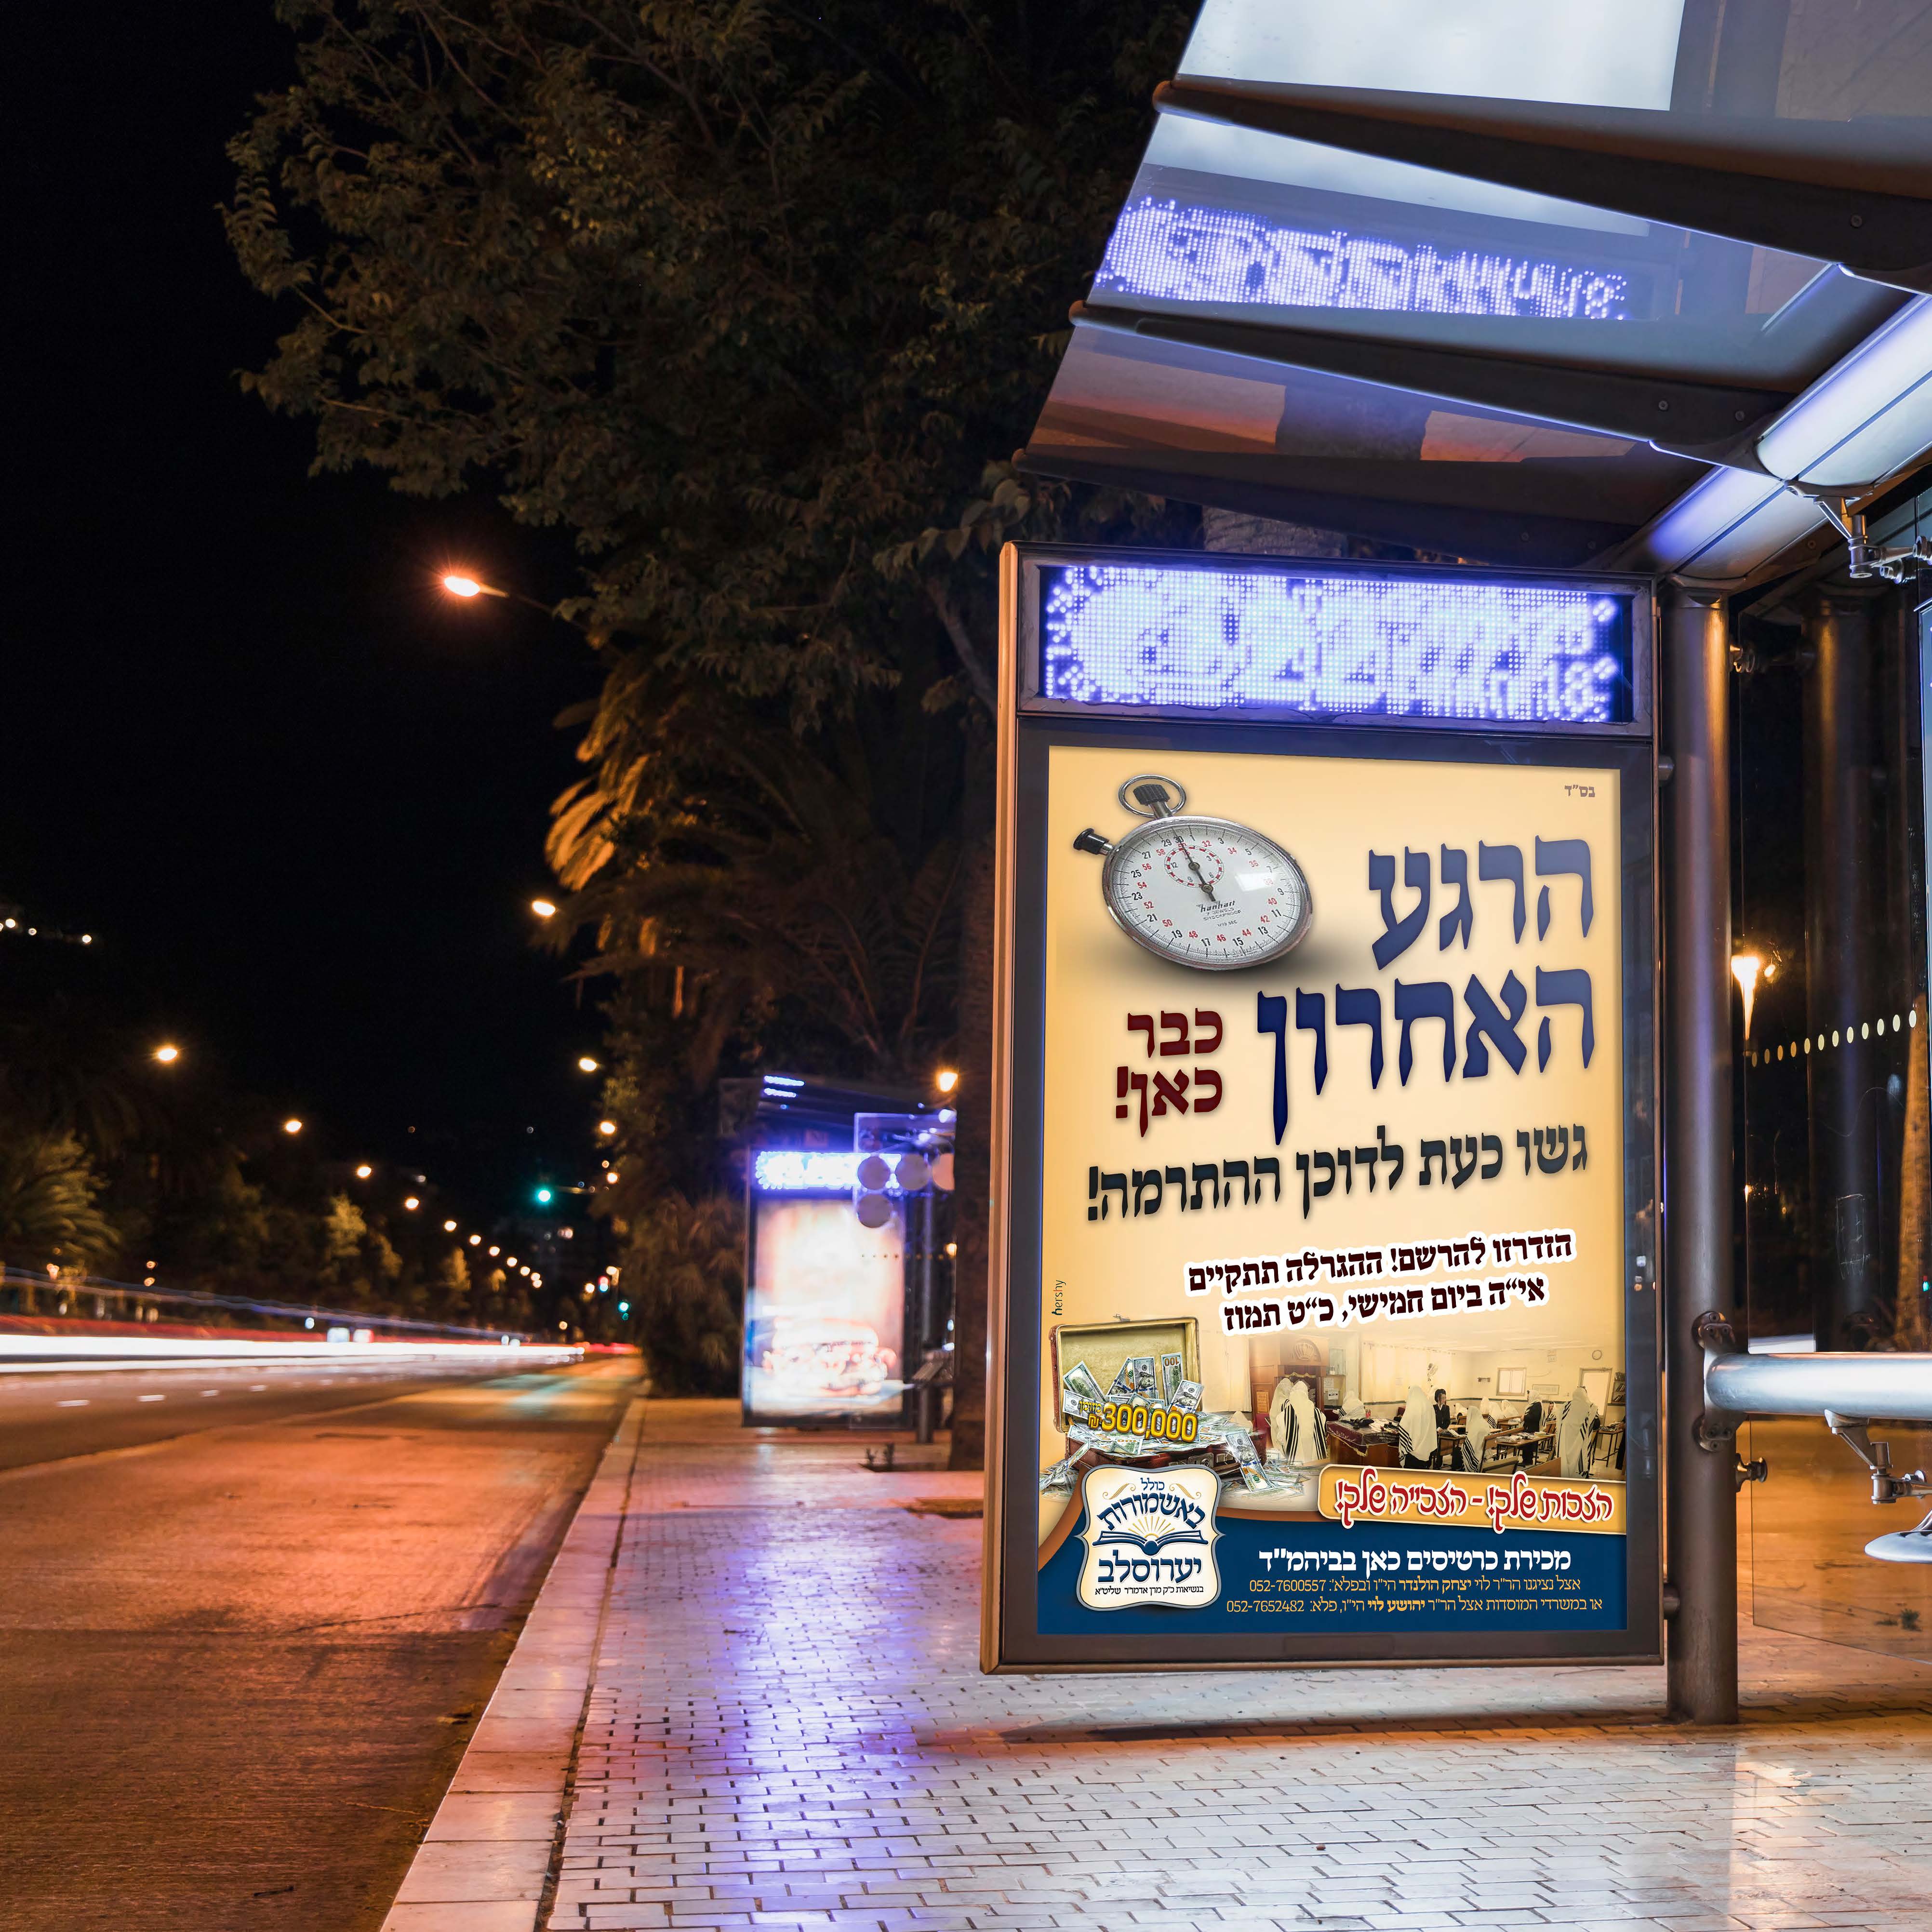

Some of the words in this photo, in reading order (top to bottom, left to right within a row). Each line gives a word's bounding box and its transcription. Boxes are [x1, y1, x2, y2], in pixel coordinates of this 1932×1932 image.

[1161, 839, 1172, 847] 29
[1142, 851, 1152, 859] 27
[1156, 848, 1166, 856] 58
[1131, 869, 1142, 878] 25
[1132, 892, 1143, 901] 23
[1369, 835, 1593, 970] הרגע
[1144, 901, 1154, 909] 52
[1147, 914, 1158, 922] 21
[1260, 915, 1271, 923] 42
[1271, 909, 1282, 918] 11
[1162, 919, 1173, 928] 50
[1258, 926, 1268, 935] 13
[1171, 929, 1183, 938] 19
[1188, 930, 1199, 939] 48
[1216, 934, 1226, 942] 46
[1241, 928, 1252, 936] 44
[1200, 937, 1211, 946] 17
[1233, 937, 1244, 946] 15
[1128, 1008, 1223, 1058] כבר
[1257, 965, 1595, 1146] האחרון
[1116, 1066, 1222, 1137] כאן!
[1517, 1124, 1587, 1176] גשו
[1419, 1133, 1503, 1189] כעת
[1296, 1125, 1403, 1219] לדוכן
[1088, 1156, 1280, 1221] ההתרמה!
[1391, 1237, 1485, 1272] להרשם!
[1493, 1234, 1572, 1262] הזדרזו
[1286, 1252, 1382, 1282] ההגרלה
[1189, 1261, 1279, 1293] תתקיים
[1052, 1279, 1066, 1316] hershy
[1431, 1284, 1482, 1310] ביום
[1489, 1278, 1544, 1305] אי"ה
[1289, 1300, 1334, 1325] כ"ט
[1342, 1290, 1423, 1322] חמישי,
[1225, 1305, 1280, 1331] תמוז
[1164, 1357, 1179, 1366] 100
[1140, 1478, 1165, 1491] כולל
[1097, 1493, 1205, 1531] באשמורות
[1098, 1550, 1201, 1583] יערוסלב
[1259, 1548, 1356, 1572] בביהמ"ד
[1362, 1550, 1400, 1579] כאן
[1407, 1550, 1498, 1571] כרטיסים
[1504, 1550, 1571, 1570] מכירת
[1250, 1580, 1326, 1591] 052-7600557
[1330, 1575, 1370, 1591] ובפלא':
[1374, 1579, 1396, 1590] הי"ו
[1399, 1575, 1439, 1590] הולנדר
[1442, 1580, 1471, 1594] יצחק
[1475, 1575, 1490, 1590] לוי
[1493, 1578, 1520, 1589] הר"ר
[1524, 1579, 1553, 1590] נציגנו
[1556, 1575, 1580, 1589] אצל
[1227, 1600, 1304, 1612] 052-7652482
[1310, 1596, 1337, 1611] פלא:
[1340, 1599, 1364, 1612] הי"ו,
[1368, 1596, 1384, 1611] לוי
[1387, 1600, 1425, 1612] יהושע
[1428, 1599, 1455, 1610] הר"ר
[1458, 1596, 1482, 1610] אצל
[1486, 1599, 1537, 1610] המוסדות
[1541, 1599, 1586, 1610] במשרדי
[1590, 1599, 1602, 1610] או
